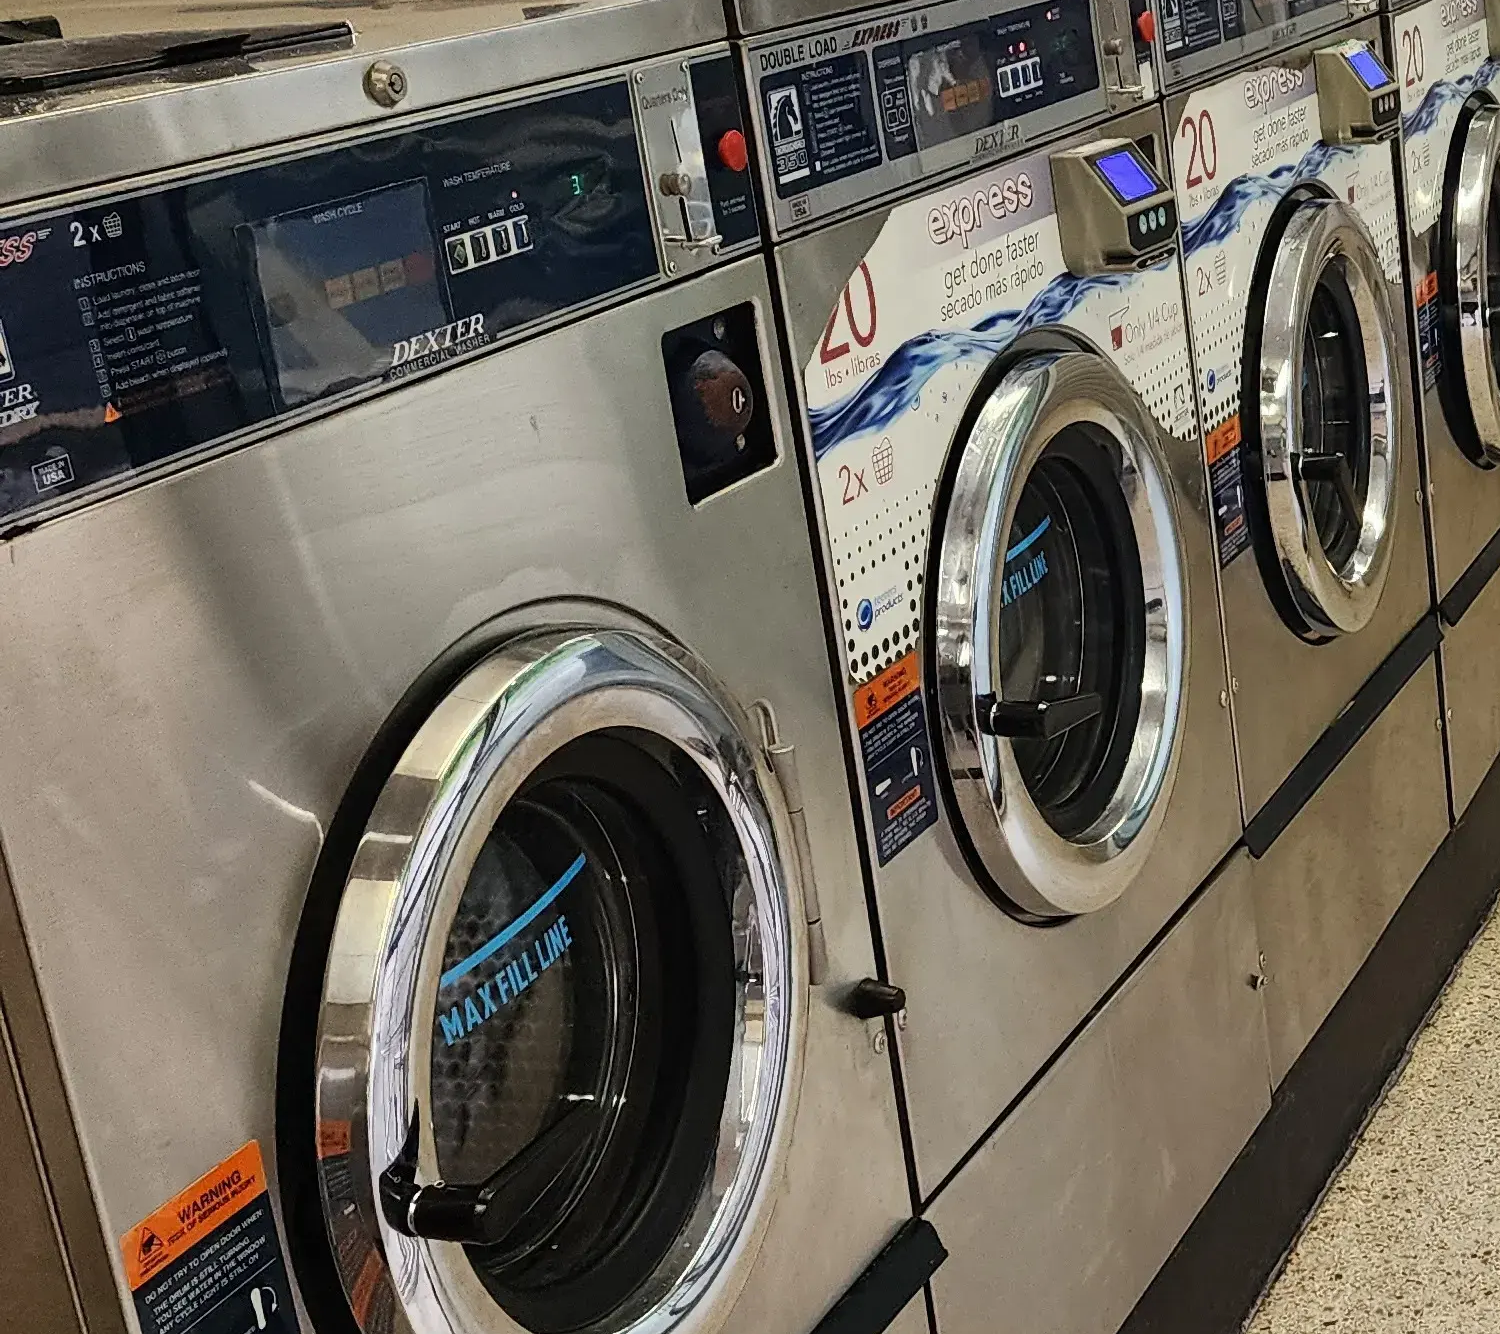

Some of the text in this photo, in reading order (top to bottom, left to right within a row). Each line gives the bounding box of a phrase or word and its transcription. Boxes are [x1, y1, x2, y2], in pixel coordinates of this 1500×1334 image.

[760, 19, 901, 71] DOUBLE LOAD EXPRESS
[1402, 24, 1424, 87] 20
[1244, 68, 1304, 115] express
[1182, 109, 1216, 189] 20
[1253, 105, 1307, 150] get done faster
[777, 149, 809, 174] 350
[337, 202, 363, 217] CYCLE
[443, 221, 461, 233] START
[928, 172, 1033, 249] express
[0, 222, 102, 266] SS 2 x
[944, 230, 1040, 299] get done faster
[73, 261, 146, 290] INSTRUCTIONS
[940, 255, 1044, 322] secado más rápido
[1196, 267, 1212, 297] 2x
[820, 259, 877, 364] 20
[389, 334, 490, 380] COMMERCIAL WASHER
[391, 313, 485, 367] DEXTER
[824, 350, 881, 389] lbs libras
[42, 471, 66, 486] USA
[839, 462, 869, 507] 2x
[874, 592, 904, 621] products
[438, 914, 574, 1047] MAX FILL LINE
[177, 1169, 241, 1223] WARNING
[144, 1290, 156, 1304] DO
[157, 1277, 172, 1294] NOT
[173, 1265, 187, 1281] TRY
[188, 1257, 199, 1269] TO
[199, 1241, 219, 1261] OPEN
[219, 1225, 241, 1245] DOOR
[153, 1298, 168, 1315] THE
[190, 1276, 198, 1286] IS
[198, 1261, 218, 1280] STILL
[199, 1282, 219, 1304] LIGHT
[220, 1276, 228, 1287] IS
[248, 1251, 258, 1264] ON
[156, 1308, 172, 1325] YOU
[172, 1296, 187, 1313] SEE
[187, 1276, 213, 1300] WATER
[213, 1269, 221, 1280] IN
[223, 1258, 236, 1273] THE
